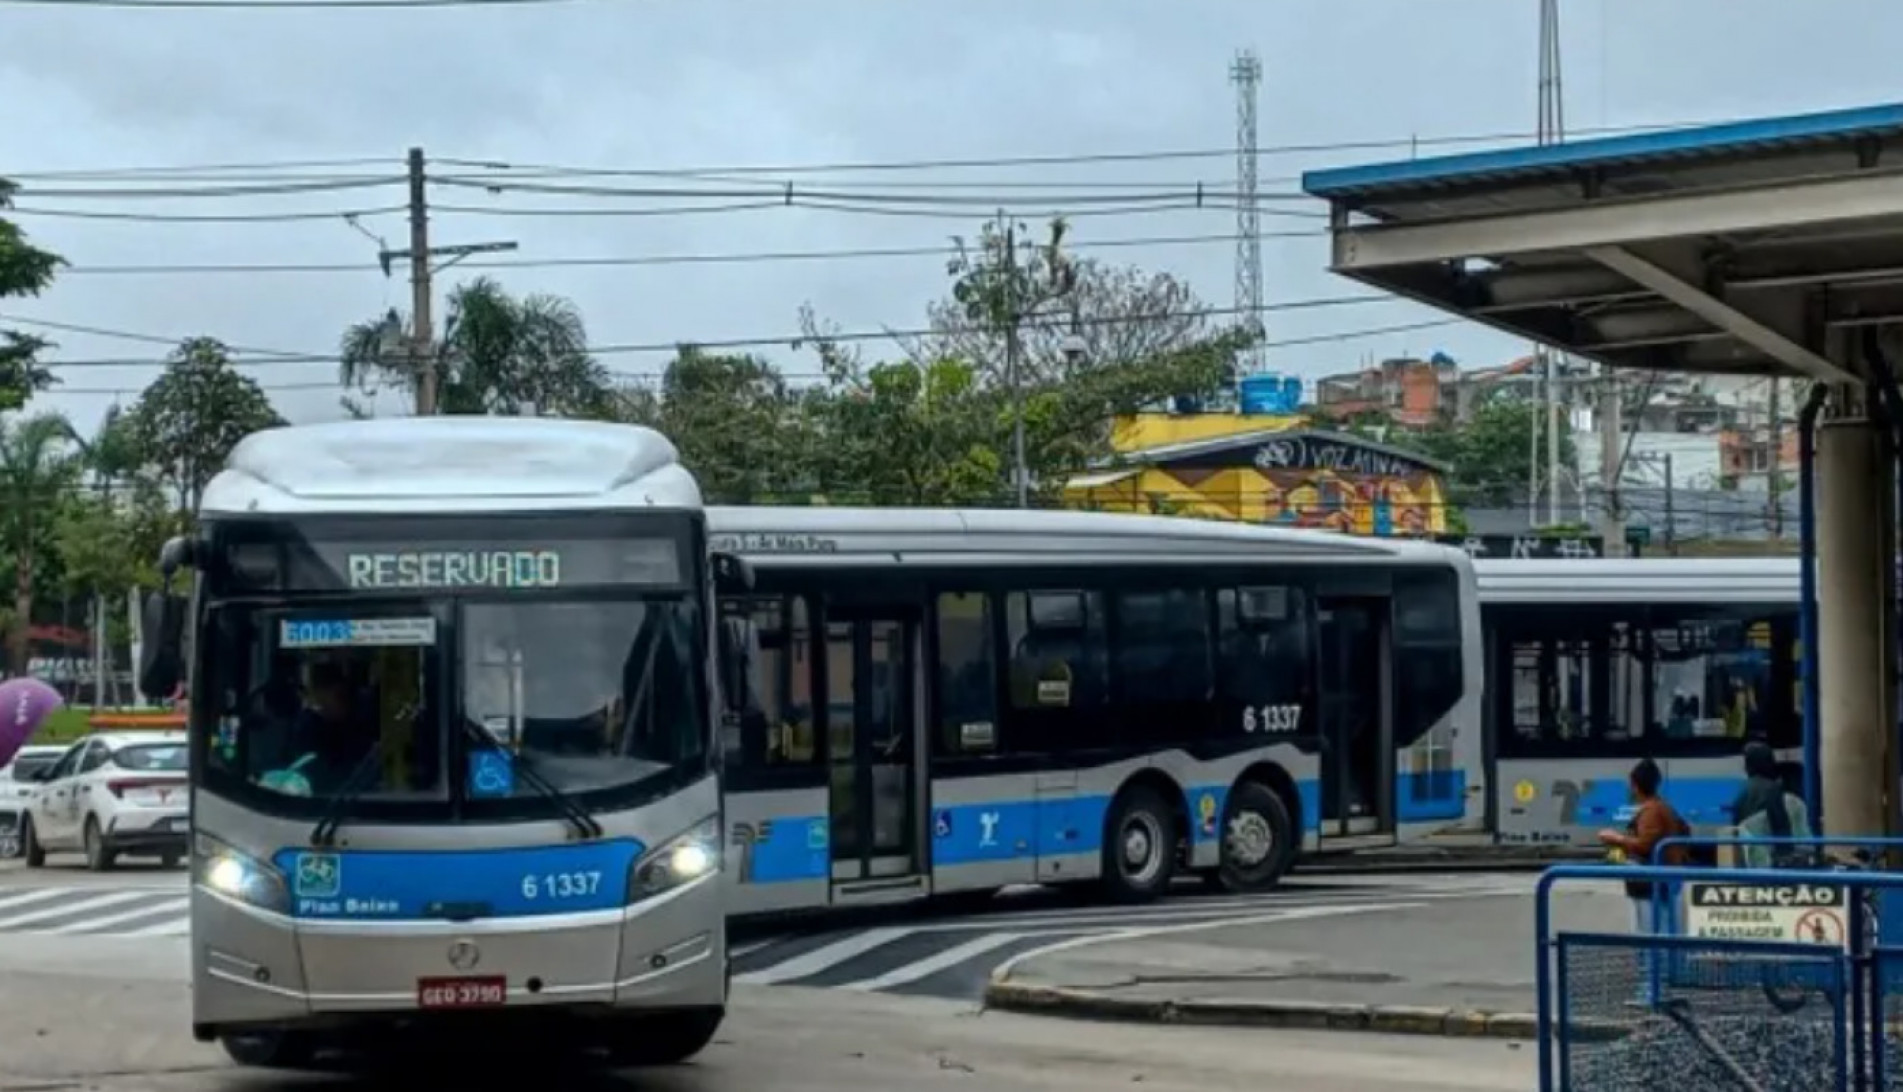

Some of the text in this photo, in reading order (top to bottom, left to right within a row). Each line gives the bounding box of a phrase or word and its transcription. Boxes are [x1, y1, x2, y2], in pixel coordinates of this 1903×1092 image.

[349, 551, 560, 588] RESERVADO
[1243, 703, 1302, 732] 6 1337
[522, 871, 602, 898] 6 1337
[1701, 884, 1836, 906] ATENÇÃO
[1707, 910, 1774, 923] PROIBIDA
